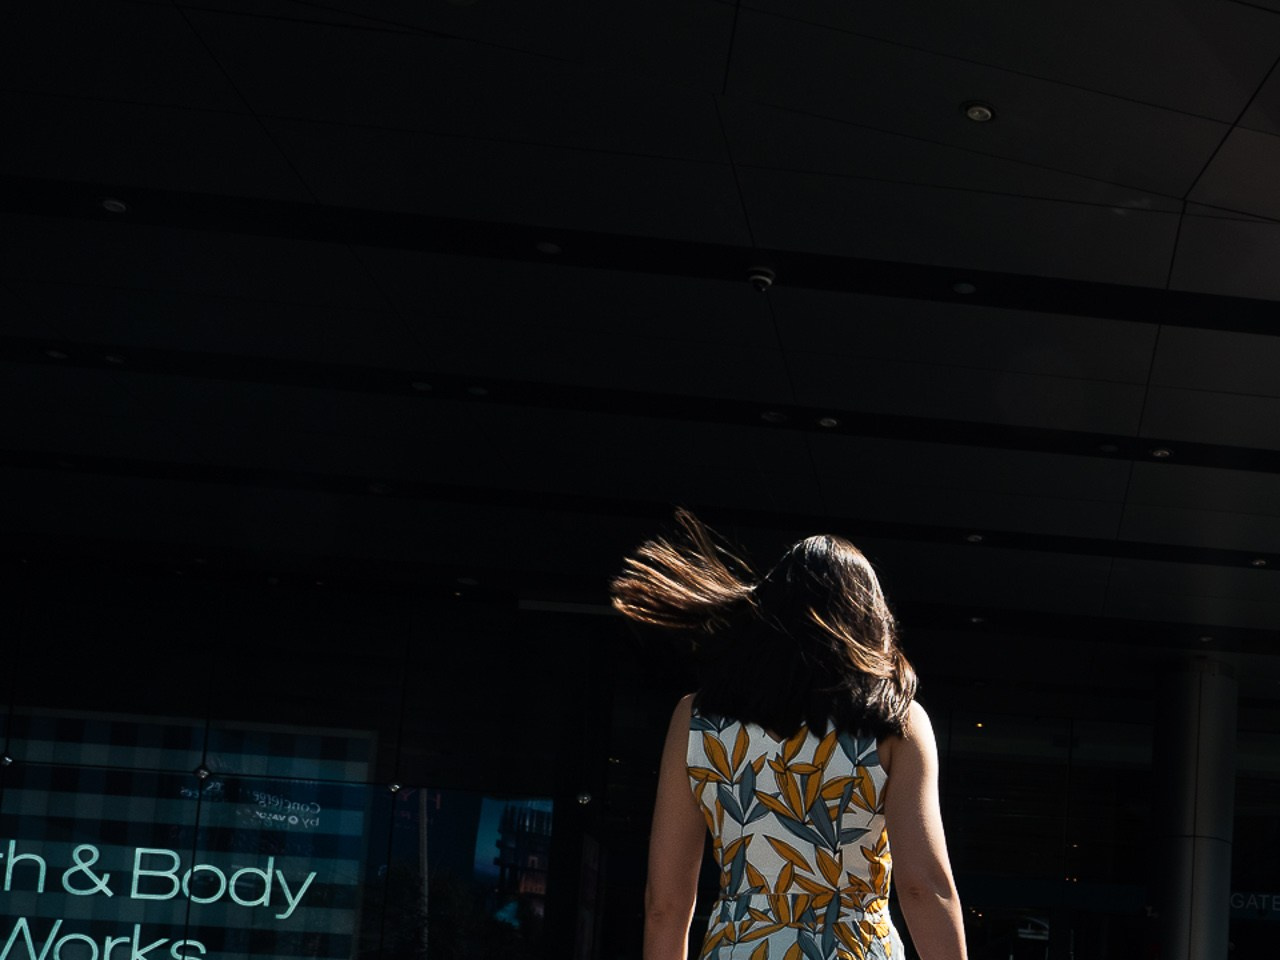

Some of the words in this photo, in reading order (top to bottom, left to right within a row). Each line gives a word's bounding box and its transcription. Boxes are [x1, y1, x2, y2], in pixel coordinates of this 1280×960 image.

[0, 839, 47, 893] h
[62, 844, 114, 898] &
[130, 847, 317, 920] Body
